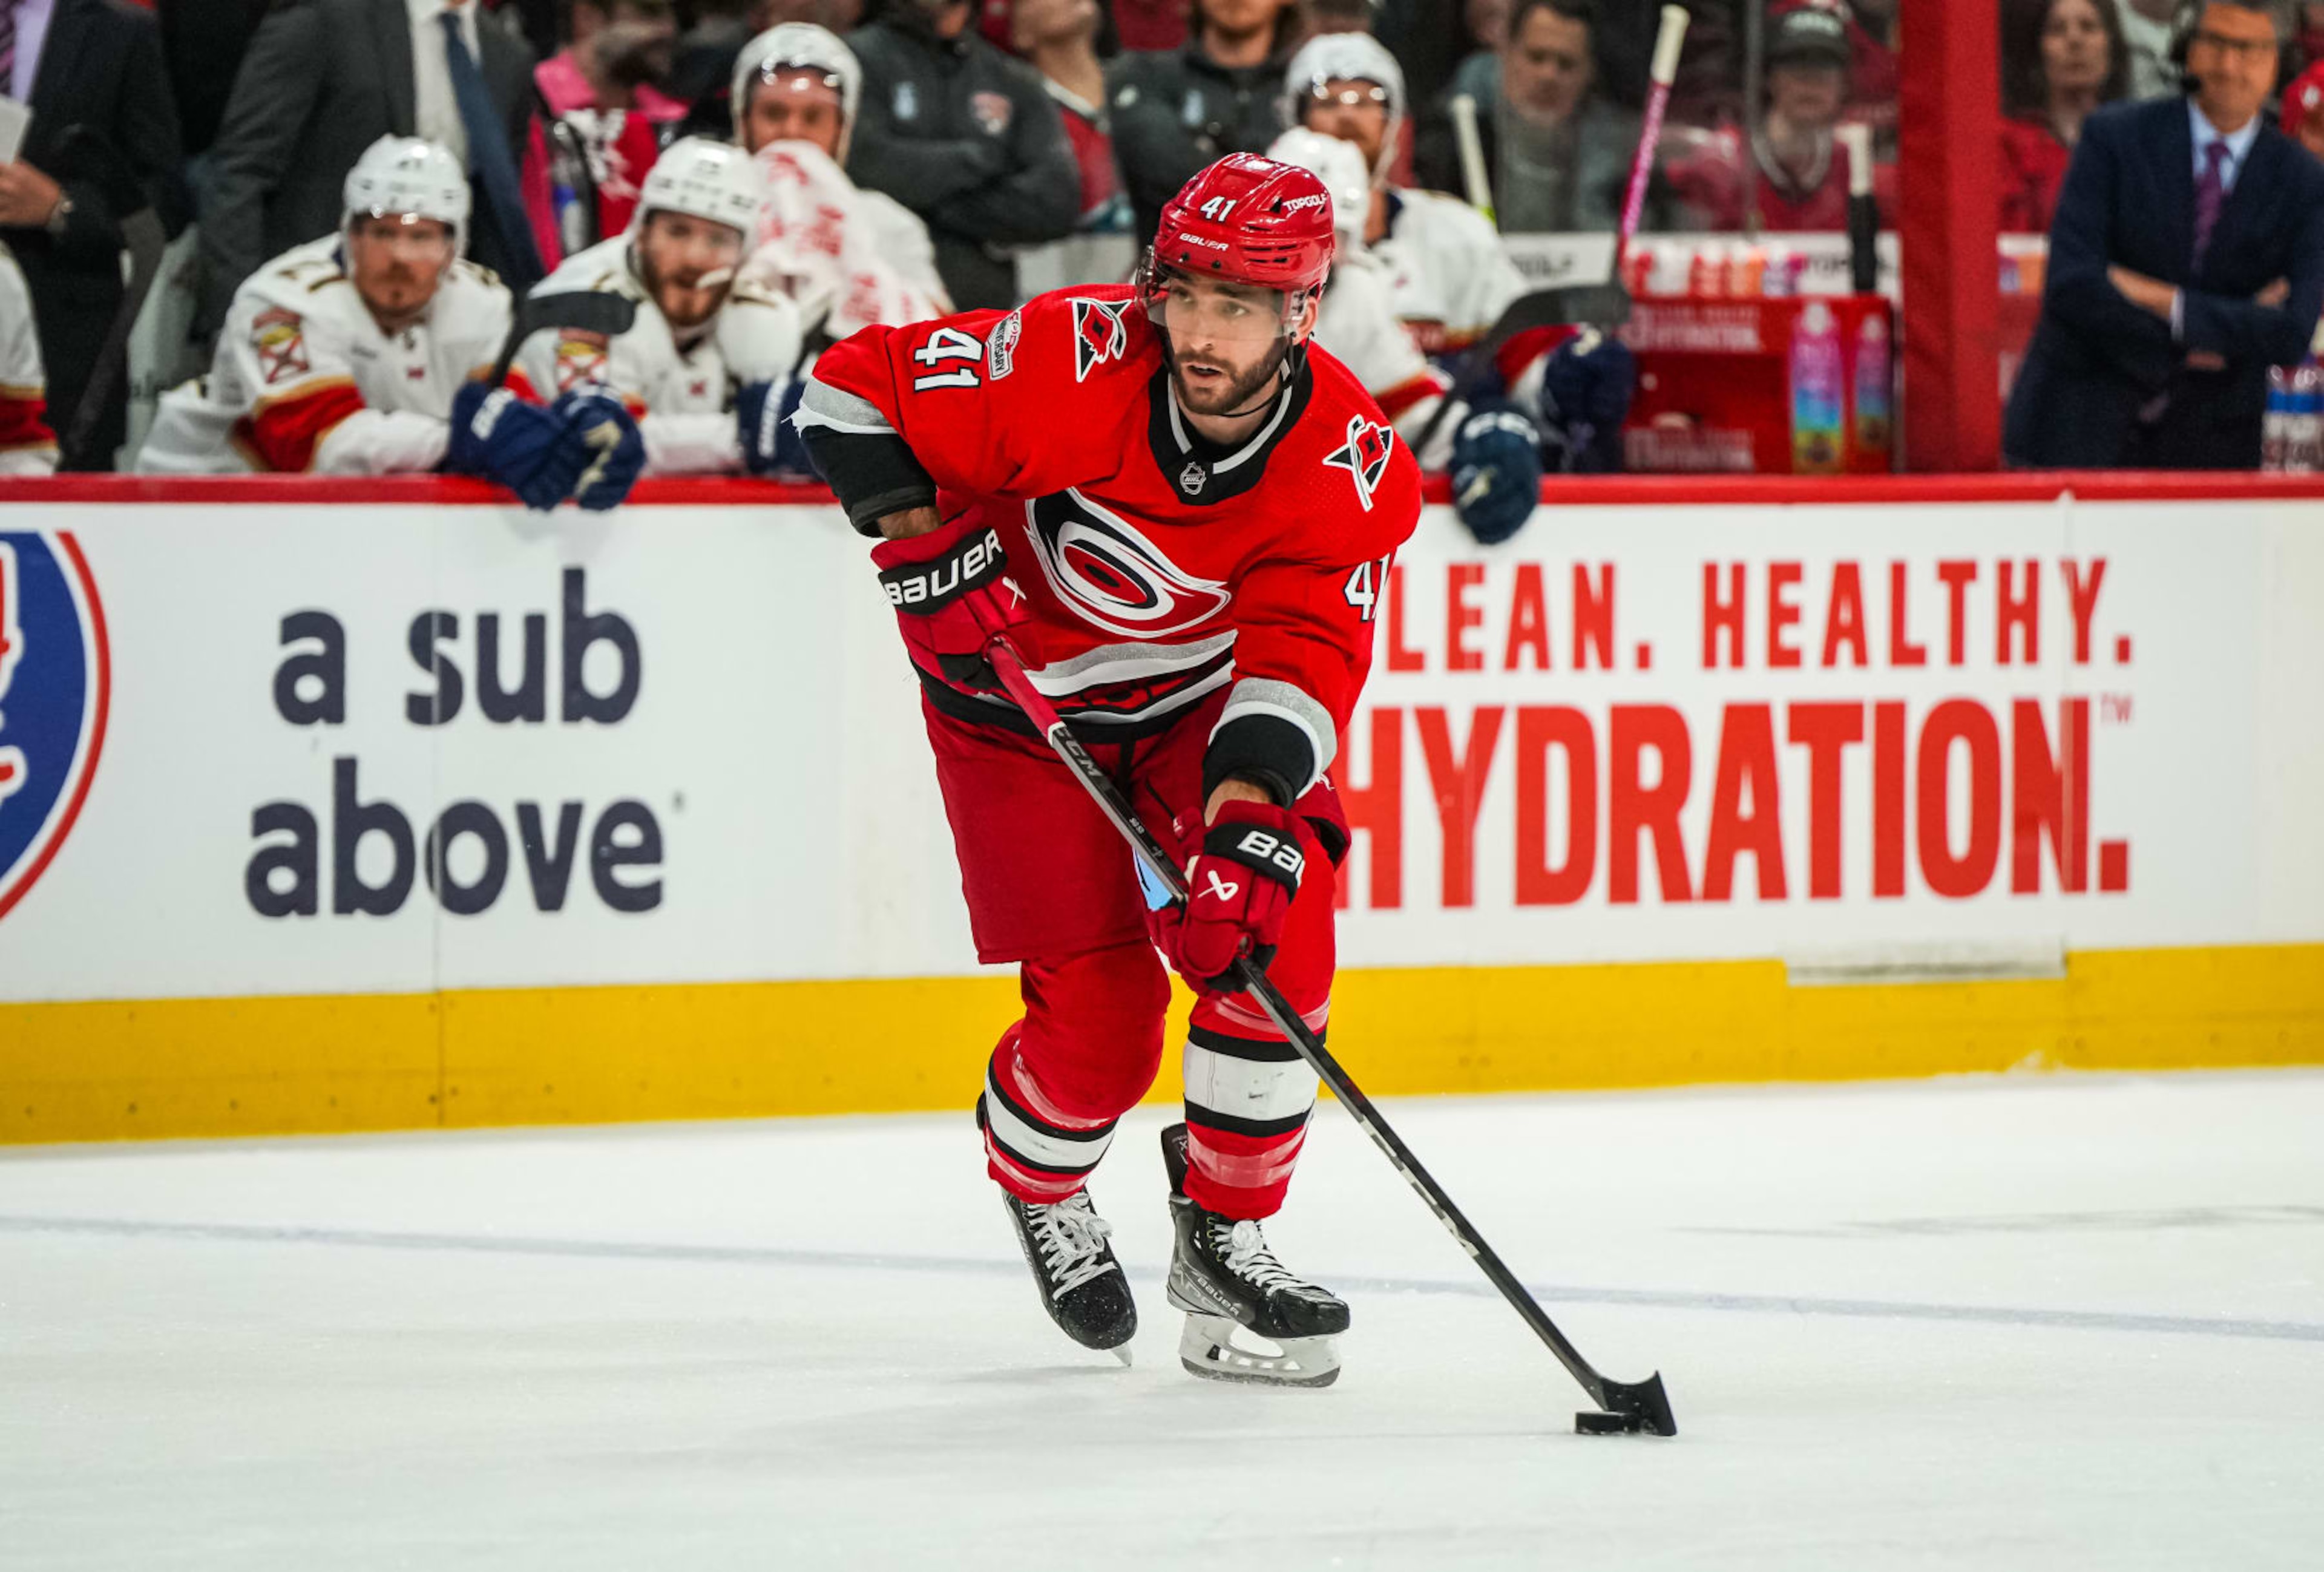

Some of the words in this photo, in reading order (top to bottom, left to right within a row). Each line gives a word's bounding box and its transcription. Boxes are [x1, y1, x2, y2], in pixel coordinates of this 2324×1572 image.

[1200, 195, 1238, 222] 41
[914, 327, 983, 392] 41
[884, 528, 1003, 606] BAUER
[1386, 562, 1652, 673] LEAN.
[1701, 558, 2132, 669] HEALTHY.
[273, 610, 346, 726] a
[405, 566, 642, 725] sub
[245, 756, 663, 918] above
[1334, 697, 2129, 909] HYDRATION.
